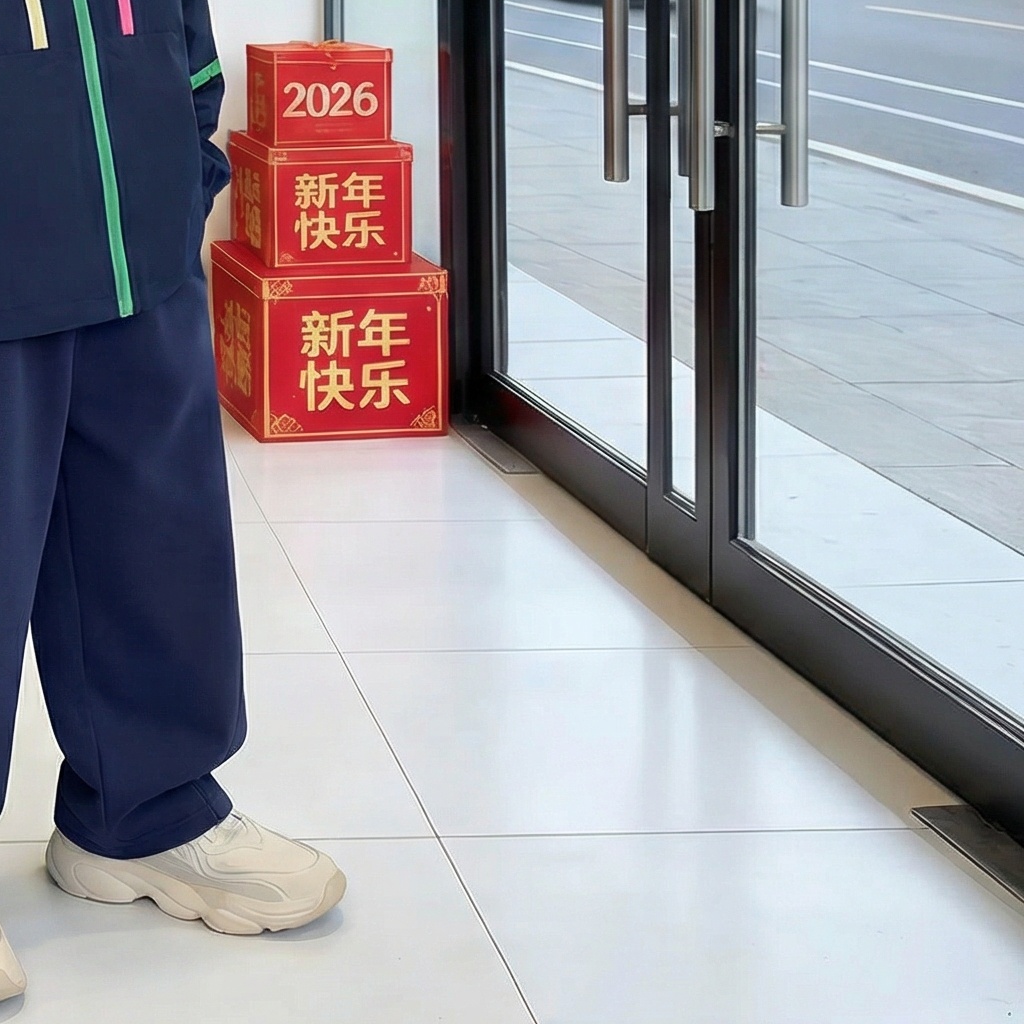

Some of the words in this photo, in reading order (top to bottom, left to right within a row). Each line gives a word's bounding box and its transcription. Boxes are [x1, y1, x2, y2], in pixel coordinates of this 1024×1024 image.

[281, 81, 379, 118] 2026
[293, 171, 386, 210] 新年
[293, 210, 387, 251] 快乐
[300, 308, 411, 358] 新年
[298, 359, 411, 412] 快乐
